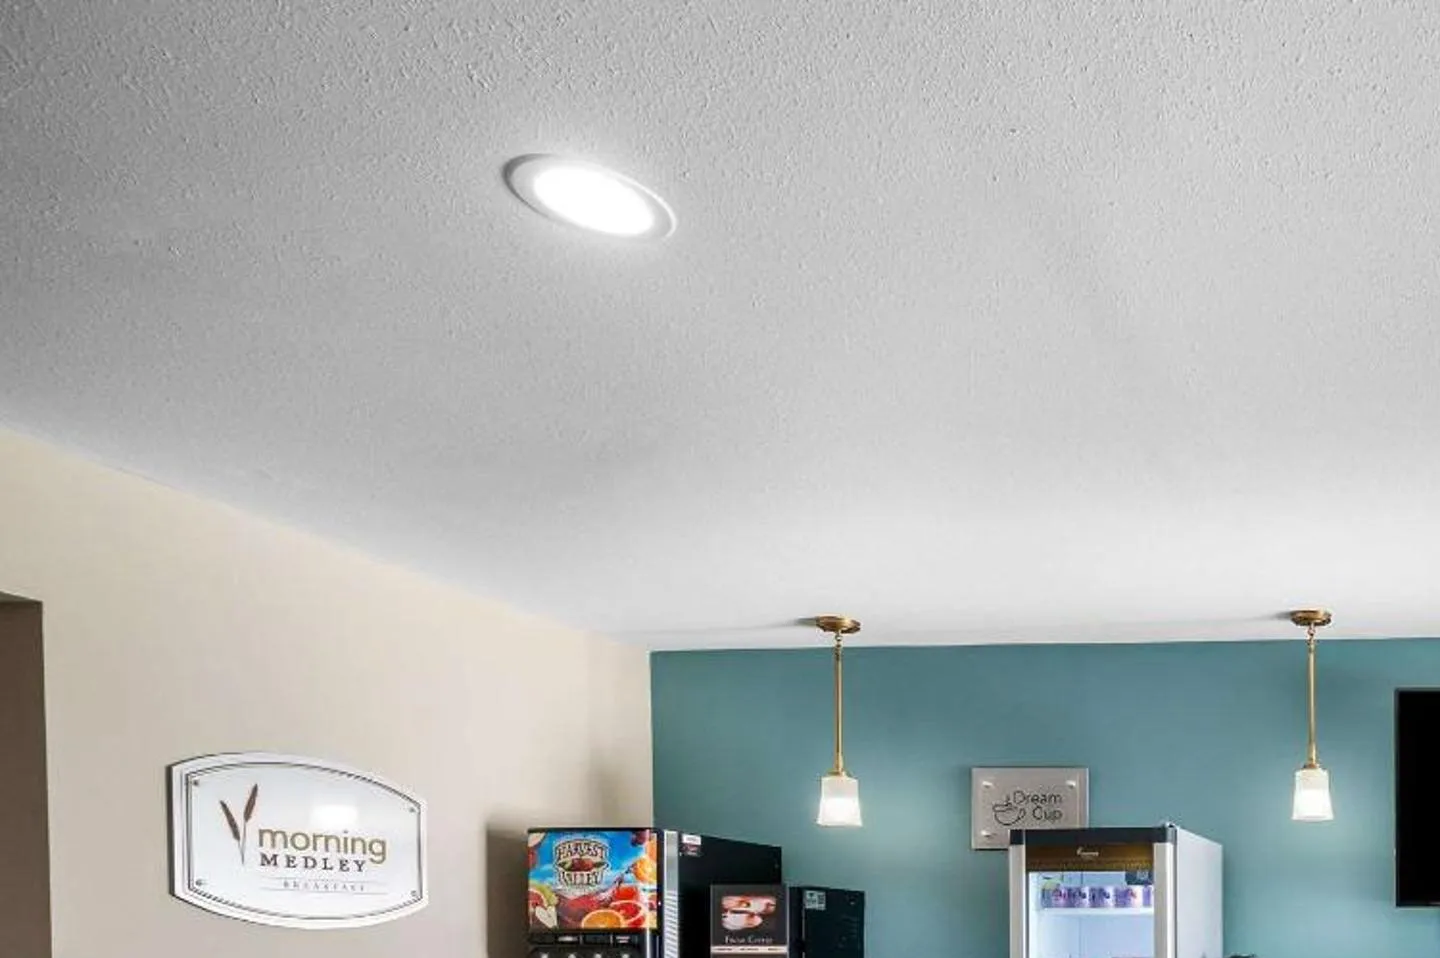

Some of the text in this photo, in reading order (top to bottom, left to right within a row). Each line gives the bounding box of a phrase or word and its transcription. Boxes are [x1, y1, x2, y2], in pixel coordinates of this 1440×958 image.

[1013, 790, 1062, 804] Dream
[1033, 806, 1063, 823] Cup
[258, 828, 386, 863] morning
[260, 854, 366, 872] MEDLEY
